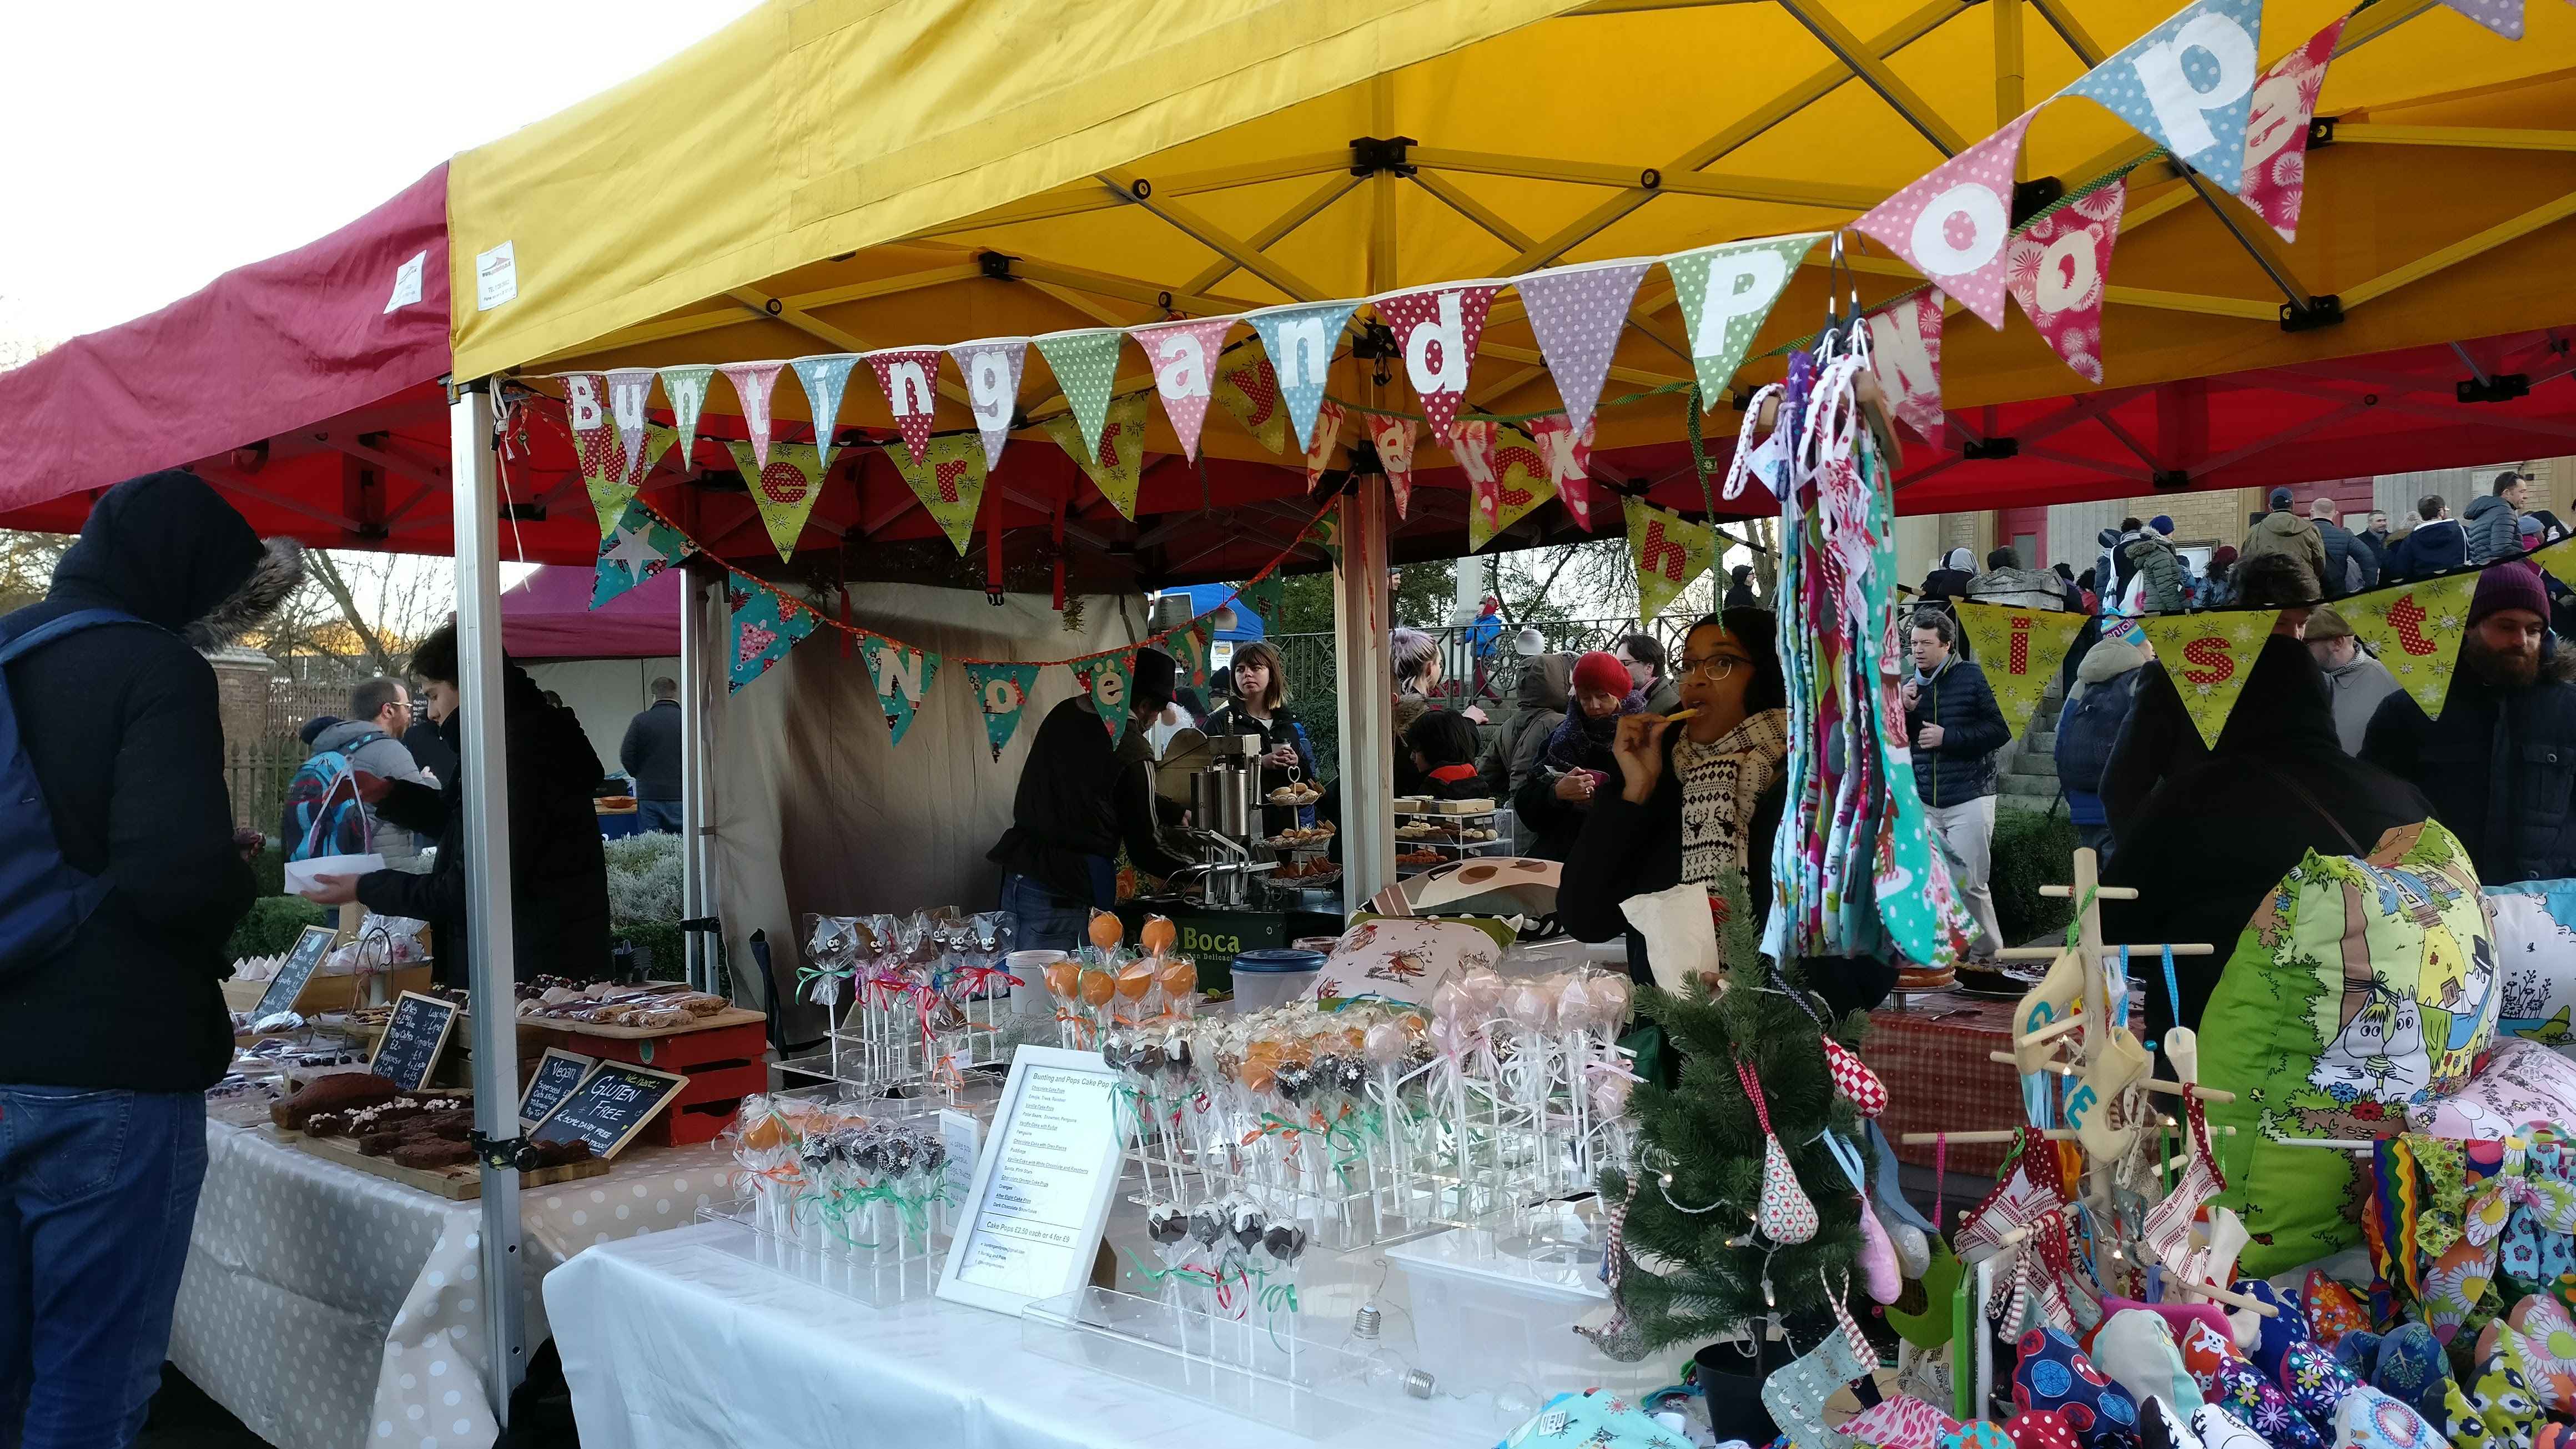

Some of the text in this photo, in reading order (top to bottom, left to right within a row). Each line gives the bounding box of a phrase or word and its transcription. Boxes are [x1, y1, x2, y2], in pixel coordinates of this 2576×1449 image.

[572, 351, 1014, 435] Bunting
[1159, 292, 1468, 400] and
[1183, 927, 1241, 953] Boca
[401, 1000, 417, 1015] Cakes
[400, 1029, 414, 1040] Cakes
[552, 1060, 576, 1083] Vegan
[625, 1074, 638, 1083] We
[1033, 1073, 1054, 1083] Bunting
[590, 1075, 642, 1102] GLUTEN
[588, 1100, 626, 1120] FREE
[578, 1121, 596, 1131] DAIRY
[594, 1128, 612, 1139] FREE
[987, 1221, 999, 1229] Cake
[1000, 1224, 1013, 1232] Pops
[1014, 1226, 1028, 1235] £2.50
